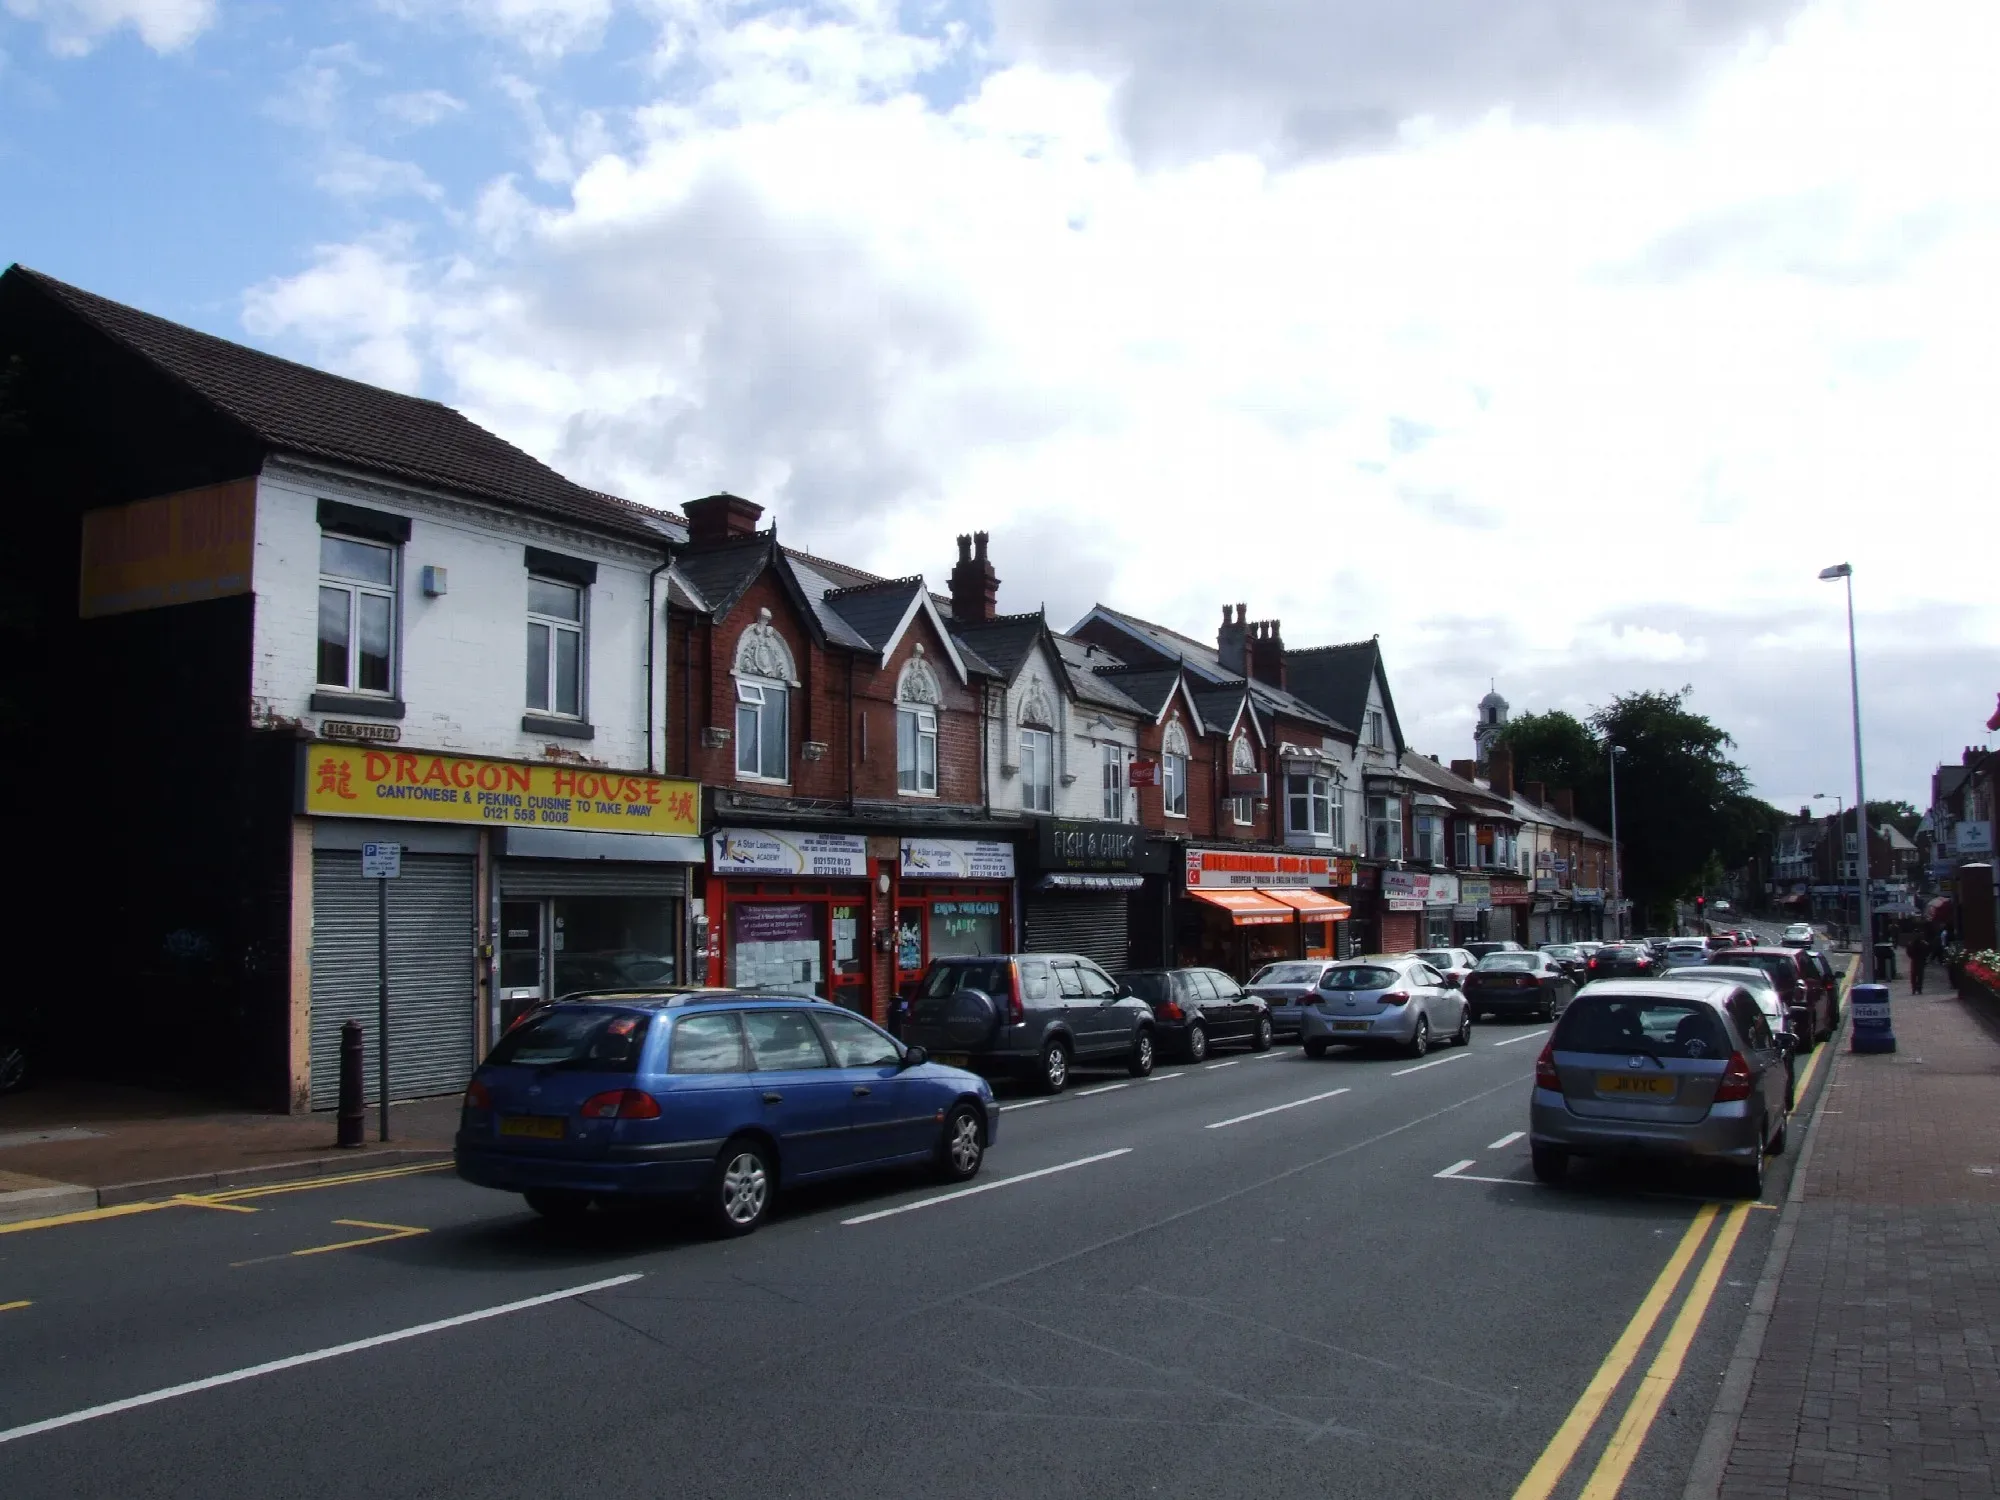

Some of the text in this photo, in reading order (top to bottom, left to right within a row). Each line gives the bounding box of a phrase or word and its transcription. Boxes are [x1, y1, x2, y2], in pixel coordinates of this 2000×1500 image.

[356, 725, 395, 738] STREET
[316, 757, 359, 799] 龍
[362, 751, 663, 804] DRAGON HOUSE
[376, 784, 652, 817] CANTONESE & PEKING CUISINE TO TAKE AWAY
[484, 806, 508, 820] 0121
[514, 808, 536, 821] 558
[736, 839, 780, 852] A Star Learning
[922, 848, 931, 856] Star
[1054, 831, 1135, 859] FISH & CHIPS
[756, 853, 780, 861] ACADEMY
